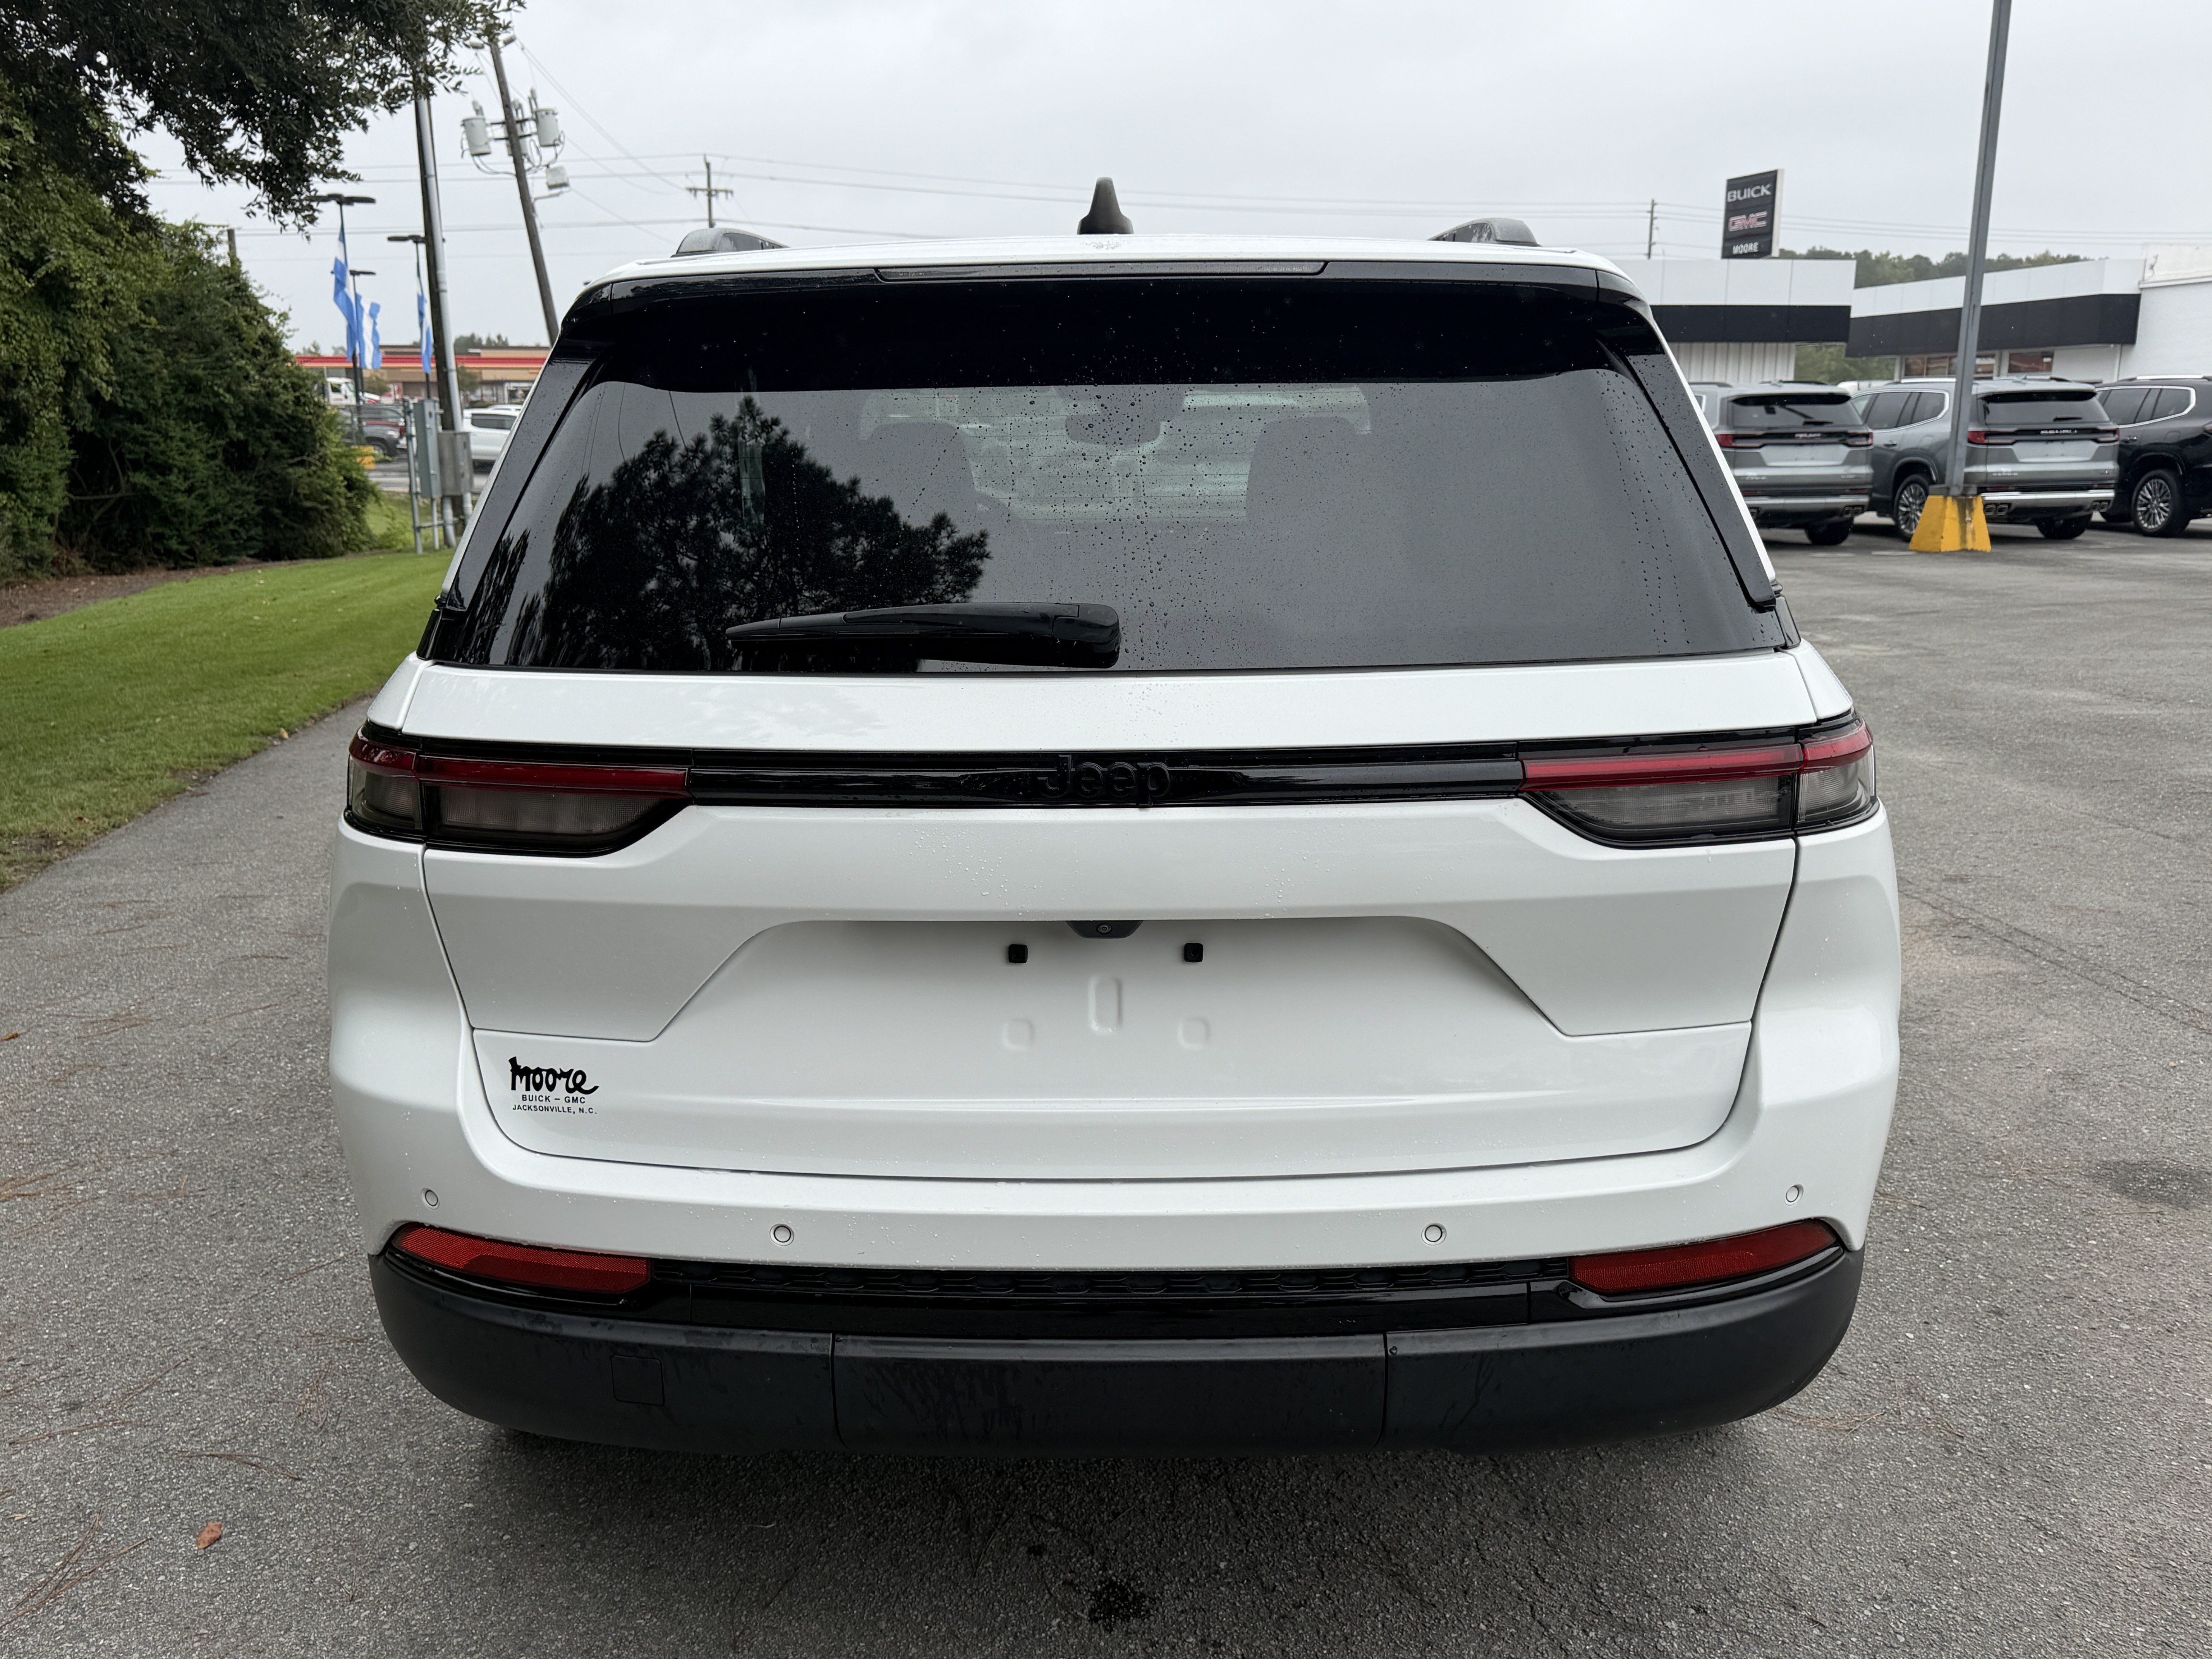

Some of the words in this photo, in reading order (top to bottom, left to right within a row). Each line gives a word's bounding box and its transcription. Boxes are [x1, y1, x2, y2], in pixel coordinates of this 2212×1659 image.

[1727, 183, 1771, 202] BUICK
[1728, 211, 1768, 232] GMC
[1732, 242, 1759, 254] MOORE
[1037, 754, 1170, 807] Jeep
[513, 1104, 575, 1114] JACKSONVILLE,
